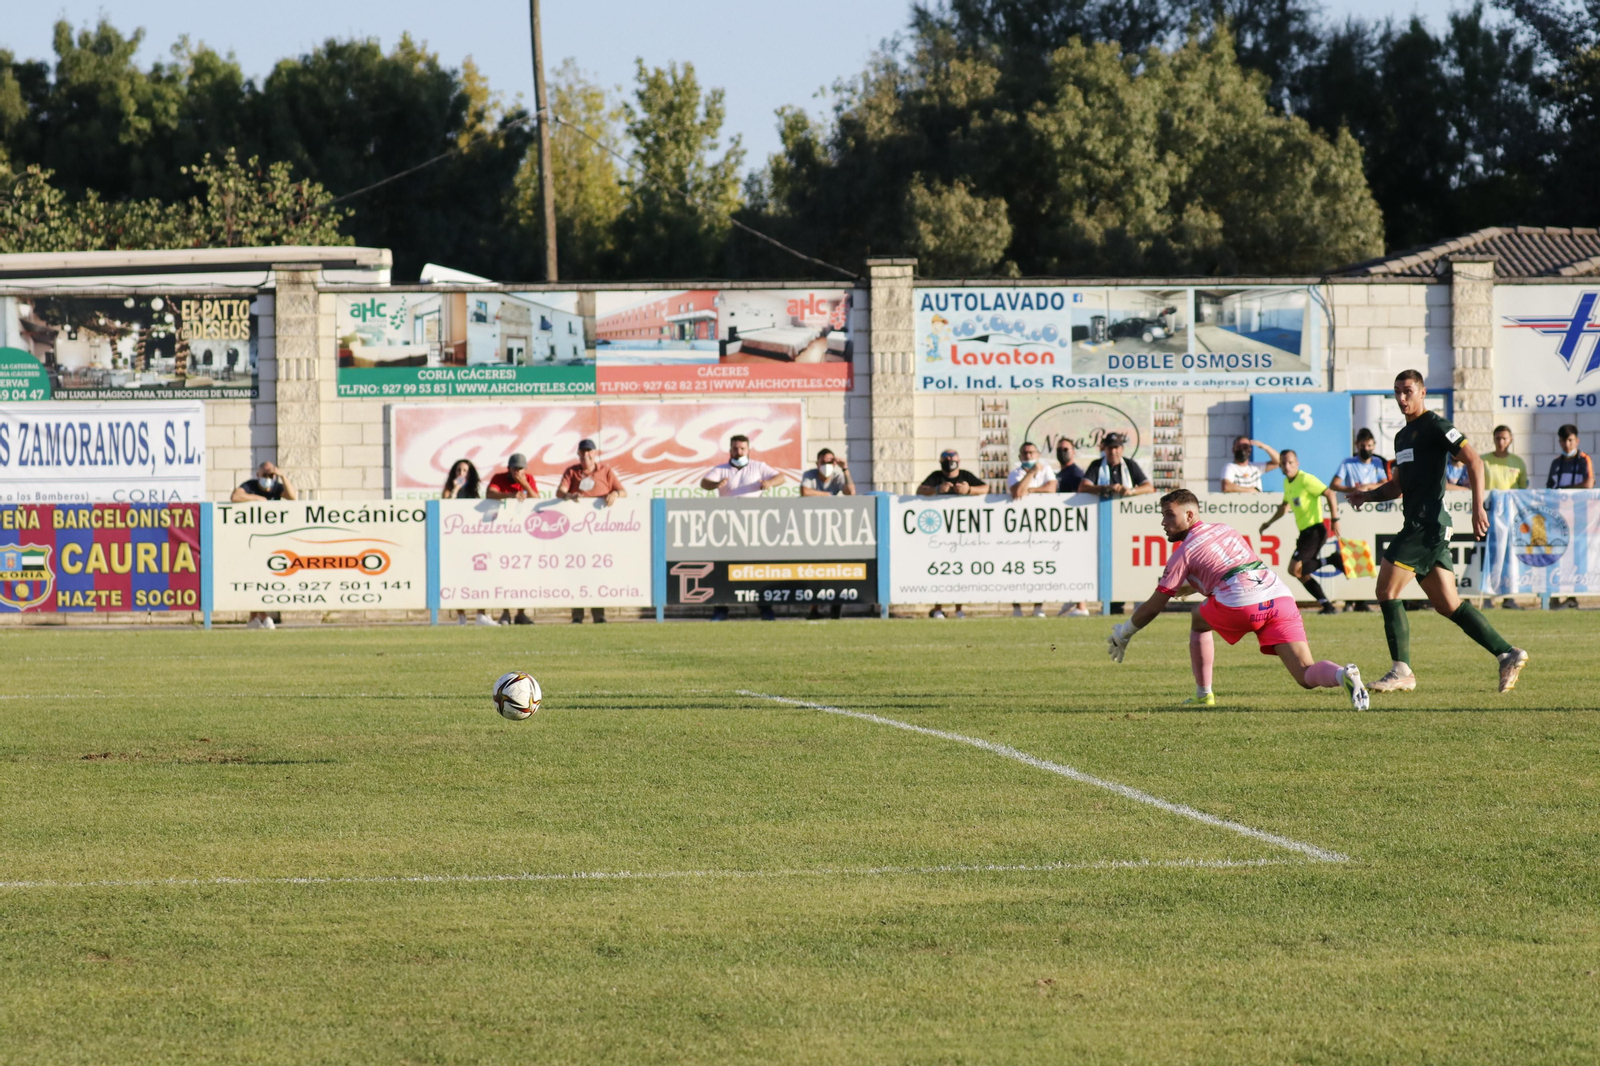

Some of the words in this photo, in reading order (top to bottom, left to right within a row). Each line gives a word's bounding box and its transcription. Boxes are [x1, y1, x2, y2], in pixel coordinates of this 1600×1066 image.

[921, 292, 1064, 311] AUTOLAVADO
[182, 300, 199, 320] EL
[203, 300, 250, 320] PATIO
[193, 320, 250, 340] DESEOS
[1108, 353, 1175, 369] DOBLE
[1182, 352, 1273, 369] OSMOSIS
[418, 370, 454, 380] CORIA
[457, 368, 516, 381] (CÁCERES)
[698, 366, 749, 377] CÁCERES
[338, 384, 380, 395] TLFNO:
[382, 384, 401, 394] 927
[403, 384, 417, 394] 99
[419, 384, 431, 394] 53
[433, 383, 446, 394] 83
[456, 382, 595, 394] WWW.AHCHOTELES.COM
[600, 382, 641, 391] TLFNO:
[643, 381, 662, 391] 927
[664, 381, 677, 390] 62
[679, 381, 692, 390] 82
[695, 380, 707, 390] 23
[714, 378, 851, 390] WWW.AHCHOTELES.COM
[923, 376, 958, 389] Pol.
[967, 375, 1002, 389] Ind.
[1010, 375, 1044, 388] Los
[1052, 374, 1129, 388] Rosales
[1133, 379, 1178, 387] (Frente
[1255, 376, 1313, 387] CORIA
[0, 389, 9, 400] 9
[12, 389, 26, 400] 04
[29, 389, 44, 400] 47
[54, 391, 67, 399] UN
[69, 391, 97, 399] LUGAR
[99, 389, 133, 399] MÁGICO
[134, 390, 156, 399] PARA
[157, 390, 173, 399] TUS
[175, 390, 209, 398] NOCHES
[211, 390, 220, 398] DE
[222, 389, 257, 398] VERANO
[1499, 395, 1528, 408] Tlf.
[1535, 394, 1568, 408] 927
[1575, 393, 1597, 407] 50
[1292, 403, 1314, 431] 3
[18, 420, 155, 476] ZAMORANOS,
[164, 420, 201, 465] S.L.
[17, 491, 31, 501] los
[35, 491, 89, 502] Bomberos)
[112, 489, 181, 502] CORIA
[0, 505, 40, 530] EÑA
[53, 508, 195, 530] BARCELONISTA
[217, 506, 289, 524] Taller
[305, 505, 426, 524] Mecánico
[903, 508, 994, 535] COVENT
[1004, 507, 1088, 534] GARDEN
[443, 513, 522, 535] Pastelería
[572, 510, 641, 535] Redondo
[668, 508, 876, 547] TECNICAURIA
[928, 534, 990, 552] English
[996, 533, 1063, 551] academy
[61, 542, 197, 574] CAURIA
[267, 554, 383, 571] GARRIDO
[499, 555, 532, 569] 927
[538, 554, 559, 569] 50
[565, 554, 586, 569] 20
[592, 554, 613, 568] 26
[0, 571, 44, 579] CORIA
[732, 565, 792, 579] oficina
[797, 564, 864, 579] técnica
[927, 561, 963, 576] 623
[970, 561, 995, 575] 00
[1002, 561, 1025, 575] 48
[1033, 561, 1056, 575] 55
[230, 582, 291, 592] TFNO.
[298, 581, 332, 591] 927
[340, 581, 371, 590] 501
[381, 581, 411, 590] 141
[440, 587, 456, 600] C/
[461, 587, 490, 599] San
[494, 586, 574, 600] Francisco,
[579, 585, 593, 598] 5.
[598, 585, 644, 598] Coria.
[899, 581, 1094, 594] www.academiacoventgarden.com
[57, 590, 122, 607] HAZTE
[135, 589, 197, 606] SOCIO
[261, 594, 327, 604] CORIA
[340, 593, 383, 603] (CC)
[735, 590, 760, 602] Tlf:
[764, 589, 791, 601] 927
[795, 589, 813, 601] 50
[817, 589, 836, 601] 40
[839, 588, 858, 600] 40
